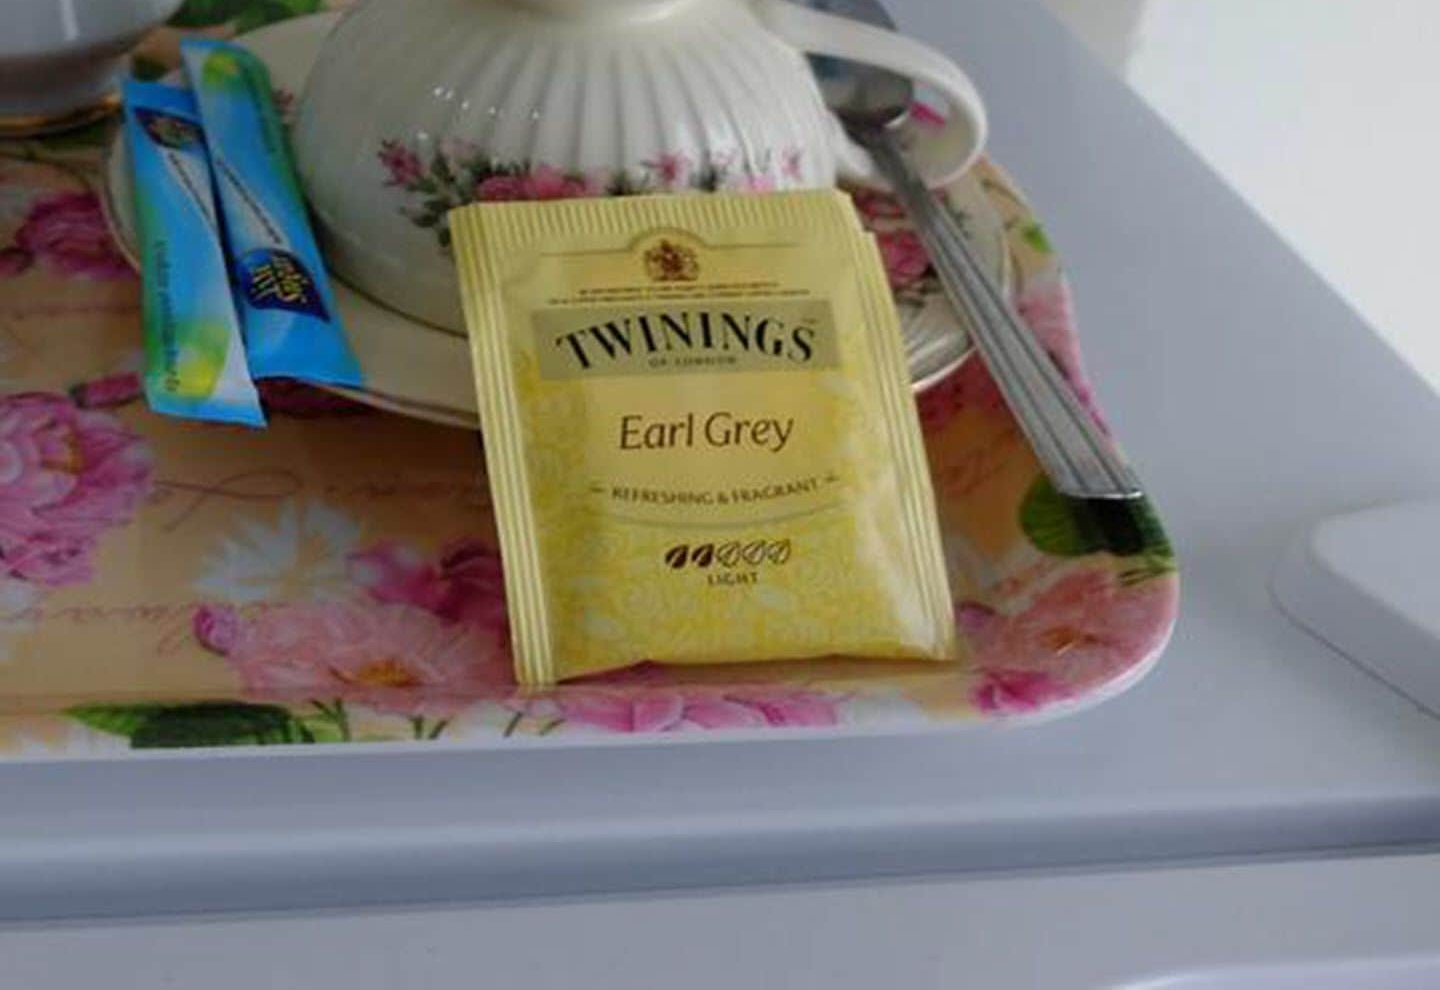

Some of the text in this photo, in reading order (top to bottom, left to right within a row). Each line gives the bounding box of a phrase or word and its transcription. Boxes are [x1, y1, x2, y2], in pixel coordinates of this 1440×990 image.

[554, 310, 816, 370] TWININGS
[619, 411, 795, 453] Earl Grey
[611, 486, 715, 505] REFRESHING
[731, 476, 818, 504] FRAGRANT
[706, 572, 759, 587] LIGHT
